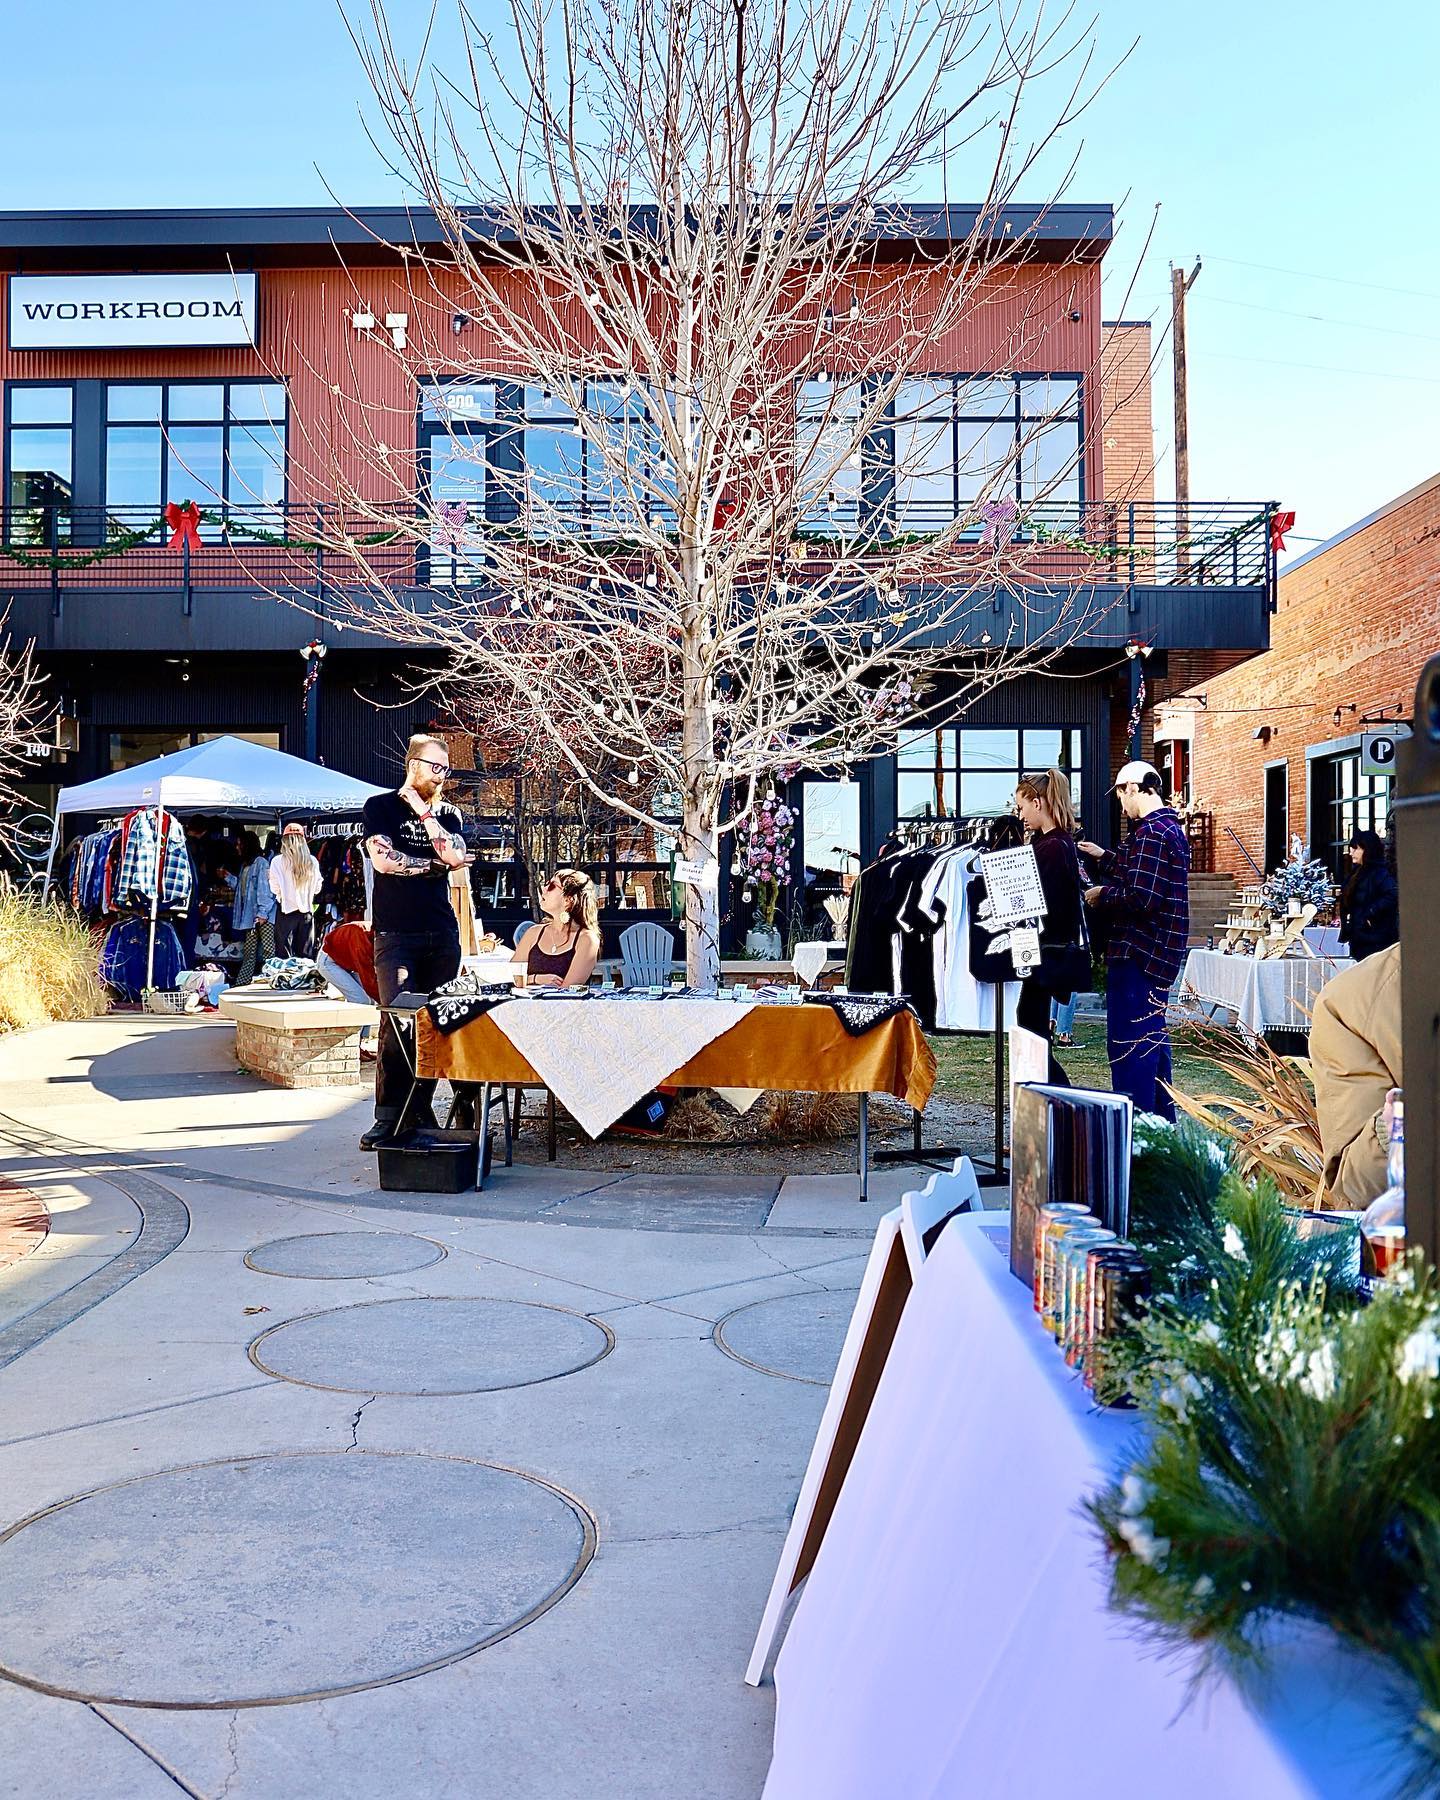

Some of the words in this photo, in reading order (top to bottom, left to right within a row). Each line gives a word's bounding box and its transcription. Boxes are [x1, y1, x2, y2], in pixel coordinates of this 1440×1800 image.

[22, 301, 243, 319] WORKROOM
[447, 394, 474, 409] 200
[25, 744, 50, 757] 140
[1377, 741, 1391, 760] P
